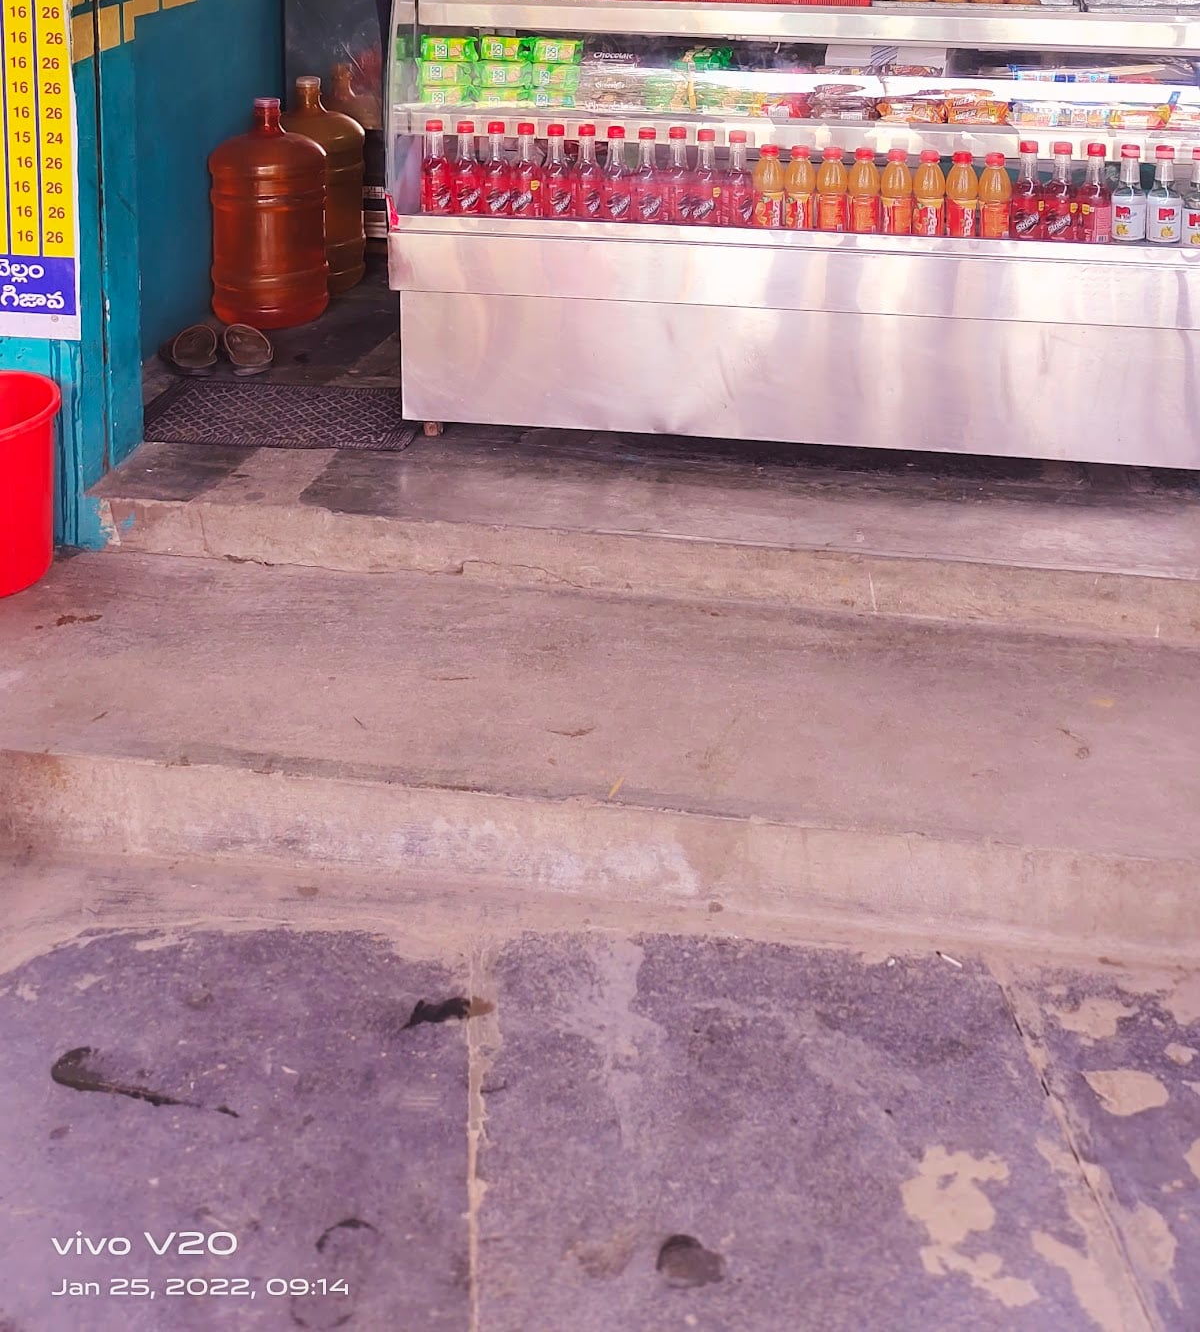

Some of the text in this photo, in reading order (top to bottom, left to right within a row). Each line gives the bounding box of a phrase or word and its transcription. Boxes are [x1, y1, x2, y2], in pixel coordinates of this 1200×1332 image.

[9, 6, 60, 20] 16 26
[10, 32, 64, 45] 16 26
[10, 57, 60, 70] 16 26
[12, 82, 62, 95] 16 26
[13, 107, 63, 120] 16 26
[14, 132, 64, 145] 15 24
[16, 156, 63, 170] 16 26
[14, 181, 63, 195] 16 26
[16, 206, 66, 220] 16 26
[927, 205, 938, 236] aaza
[963, 208, 973, 237] aaza
[17, 230, 64, 244] 16 26
